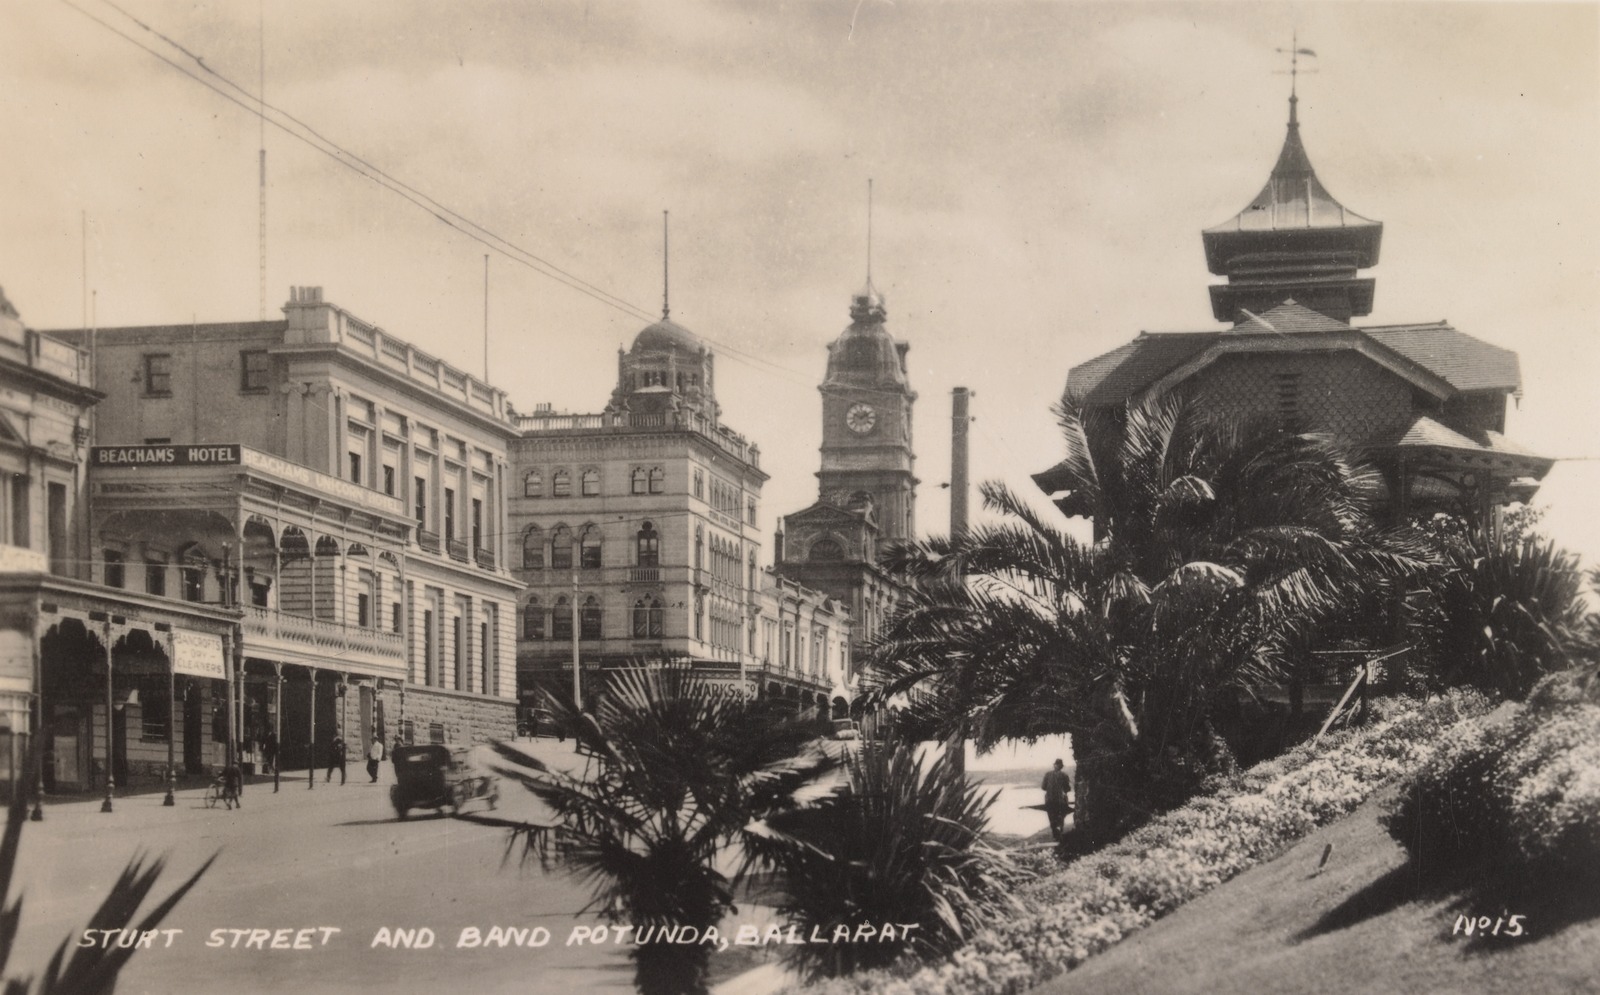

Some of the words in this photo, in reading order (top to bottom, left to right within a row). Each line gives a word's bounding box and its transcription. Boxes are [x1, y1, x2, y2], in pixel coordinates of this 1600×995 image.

[189, 448, 236, 462] HOTEL
[315, 474, 364, 500] UNICORN
[368, 492, 398, 511] HOTEL
[177, 657, 222, 674] CLEANERS
